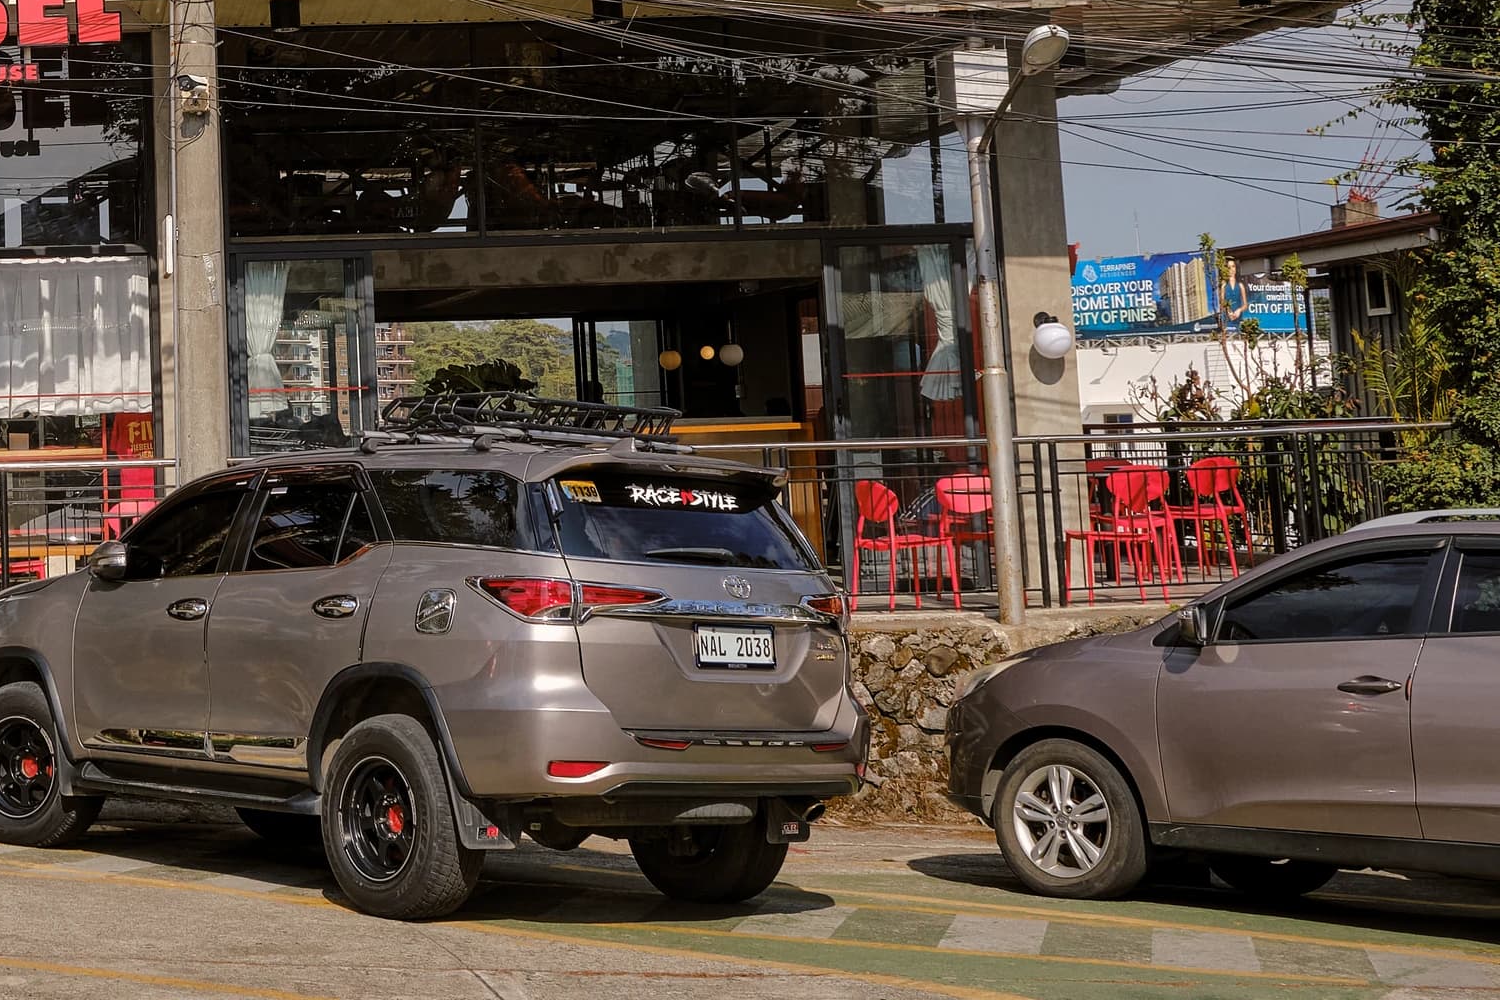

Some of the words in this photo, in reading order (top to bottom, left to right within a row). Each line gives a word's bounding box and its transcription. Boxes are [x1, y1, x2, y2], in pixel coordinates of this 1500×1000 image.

[1071, 282, 1120, 297] DISCOVER
[1122, 280, 1153, 292] YOUR
[1248, 283, 1264, 292] Your
[1072, 296, 1110, 311] HOME
[1111, 294, 1125, 308] IN
[1126, 292, 1154, 308] THE
[1248, 303, 1269, 313] CITY
[1271, 303, 1283, 313] OF
[1073, 311, 1099, 326] CITY
[1101, 310, 1118, 323] OF
[1120, 308, 1157, 323] PINES
[572, 486, 598, 497] 1139
[700, 636, 726, 657] NAL
[736, 637, 771, 657] 2038
